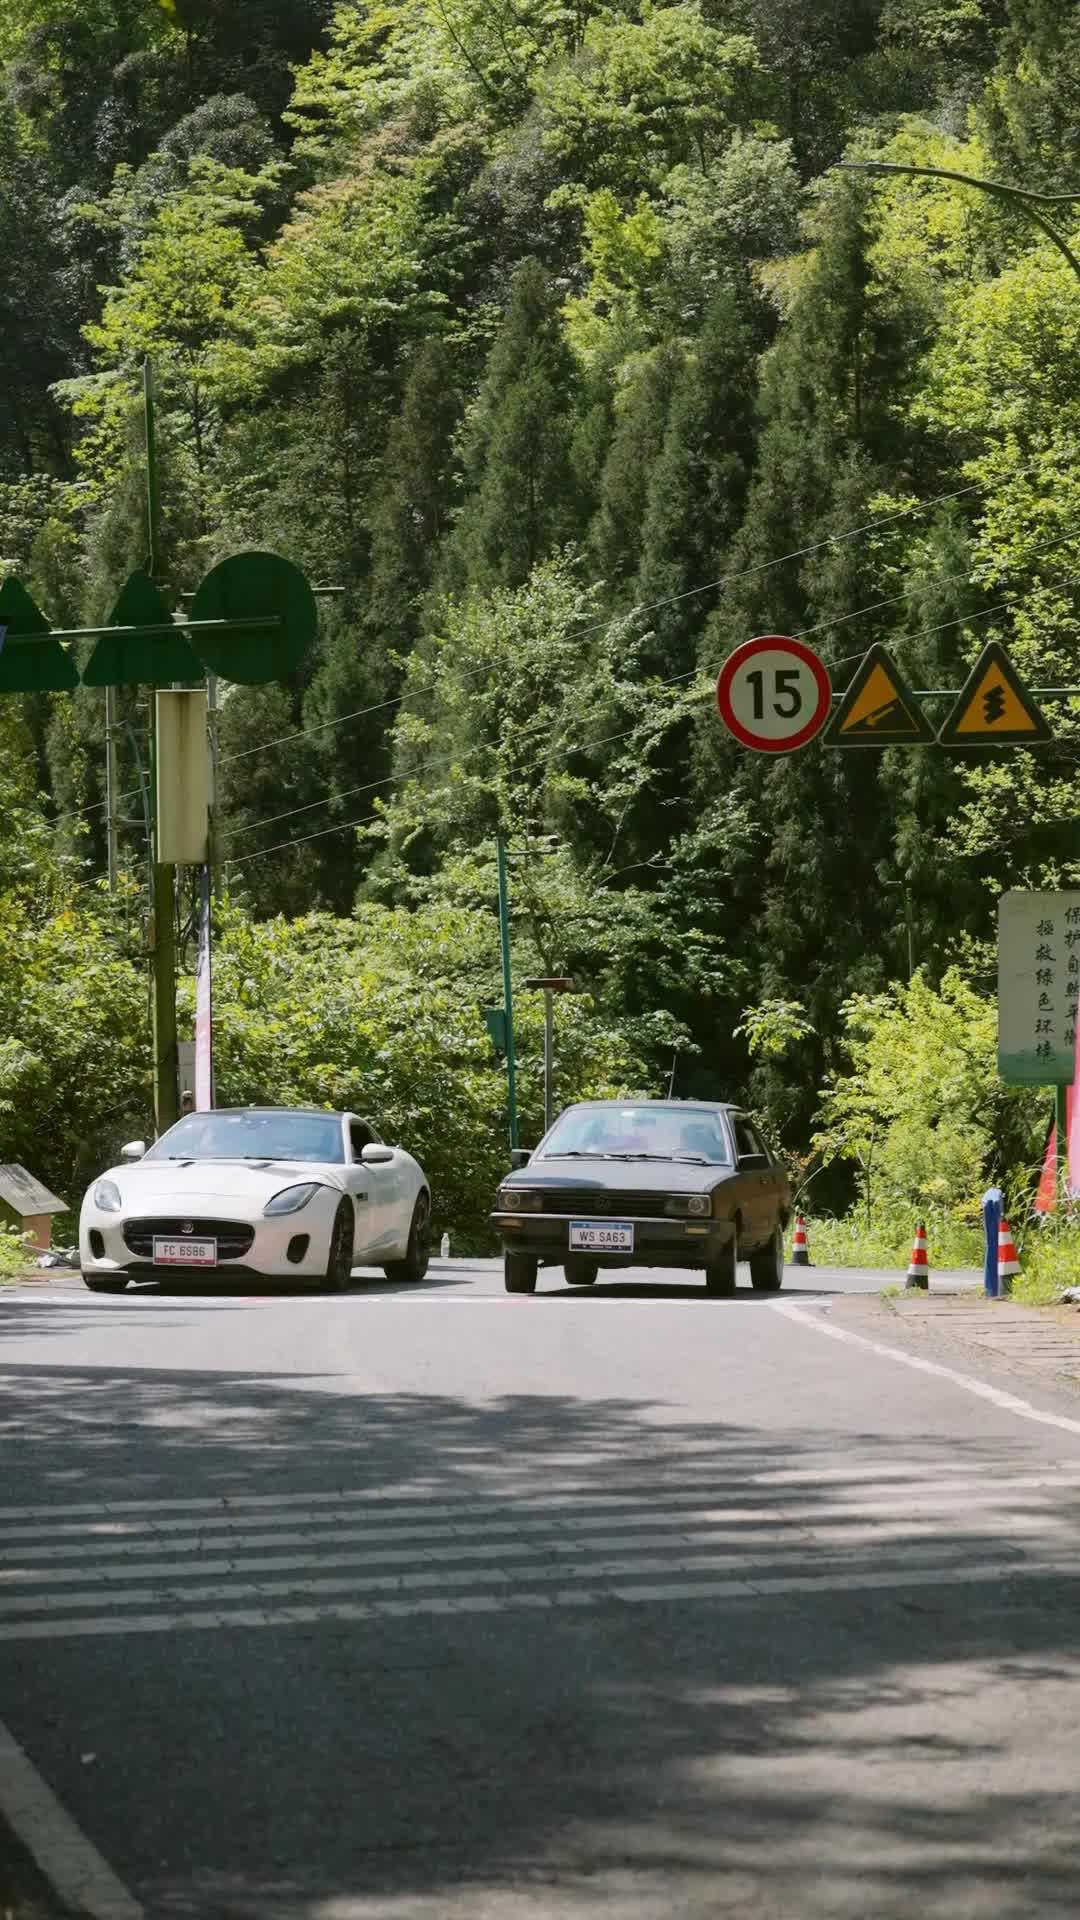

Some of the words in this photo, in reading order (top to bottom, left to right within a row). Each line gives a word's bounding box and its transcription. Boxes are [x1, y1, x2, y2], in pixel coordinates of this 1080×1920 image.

[746, 670, 802, 720] 15
[579, 1231, 595, 1242] WS
[163, 1244, 176, 1256] FC
